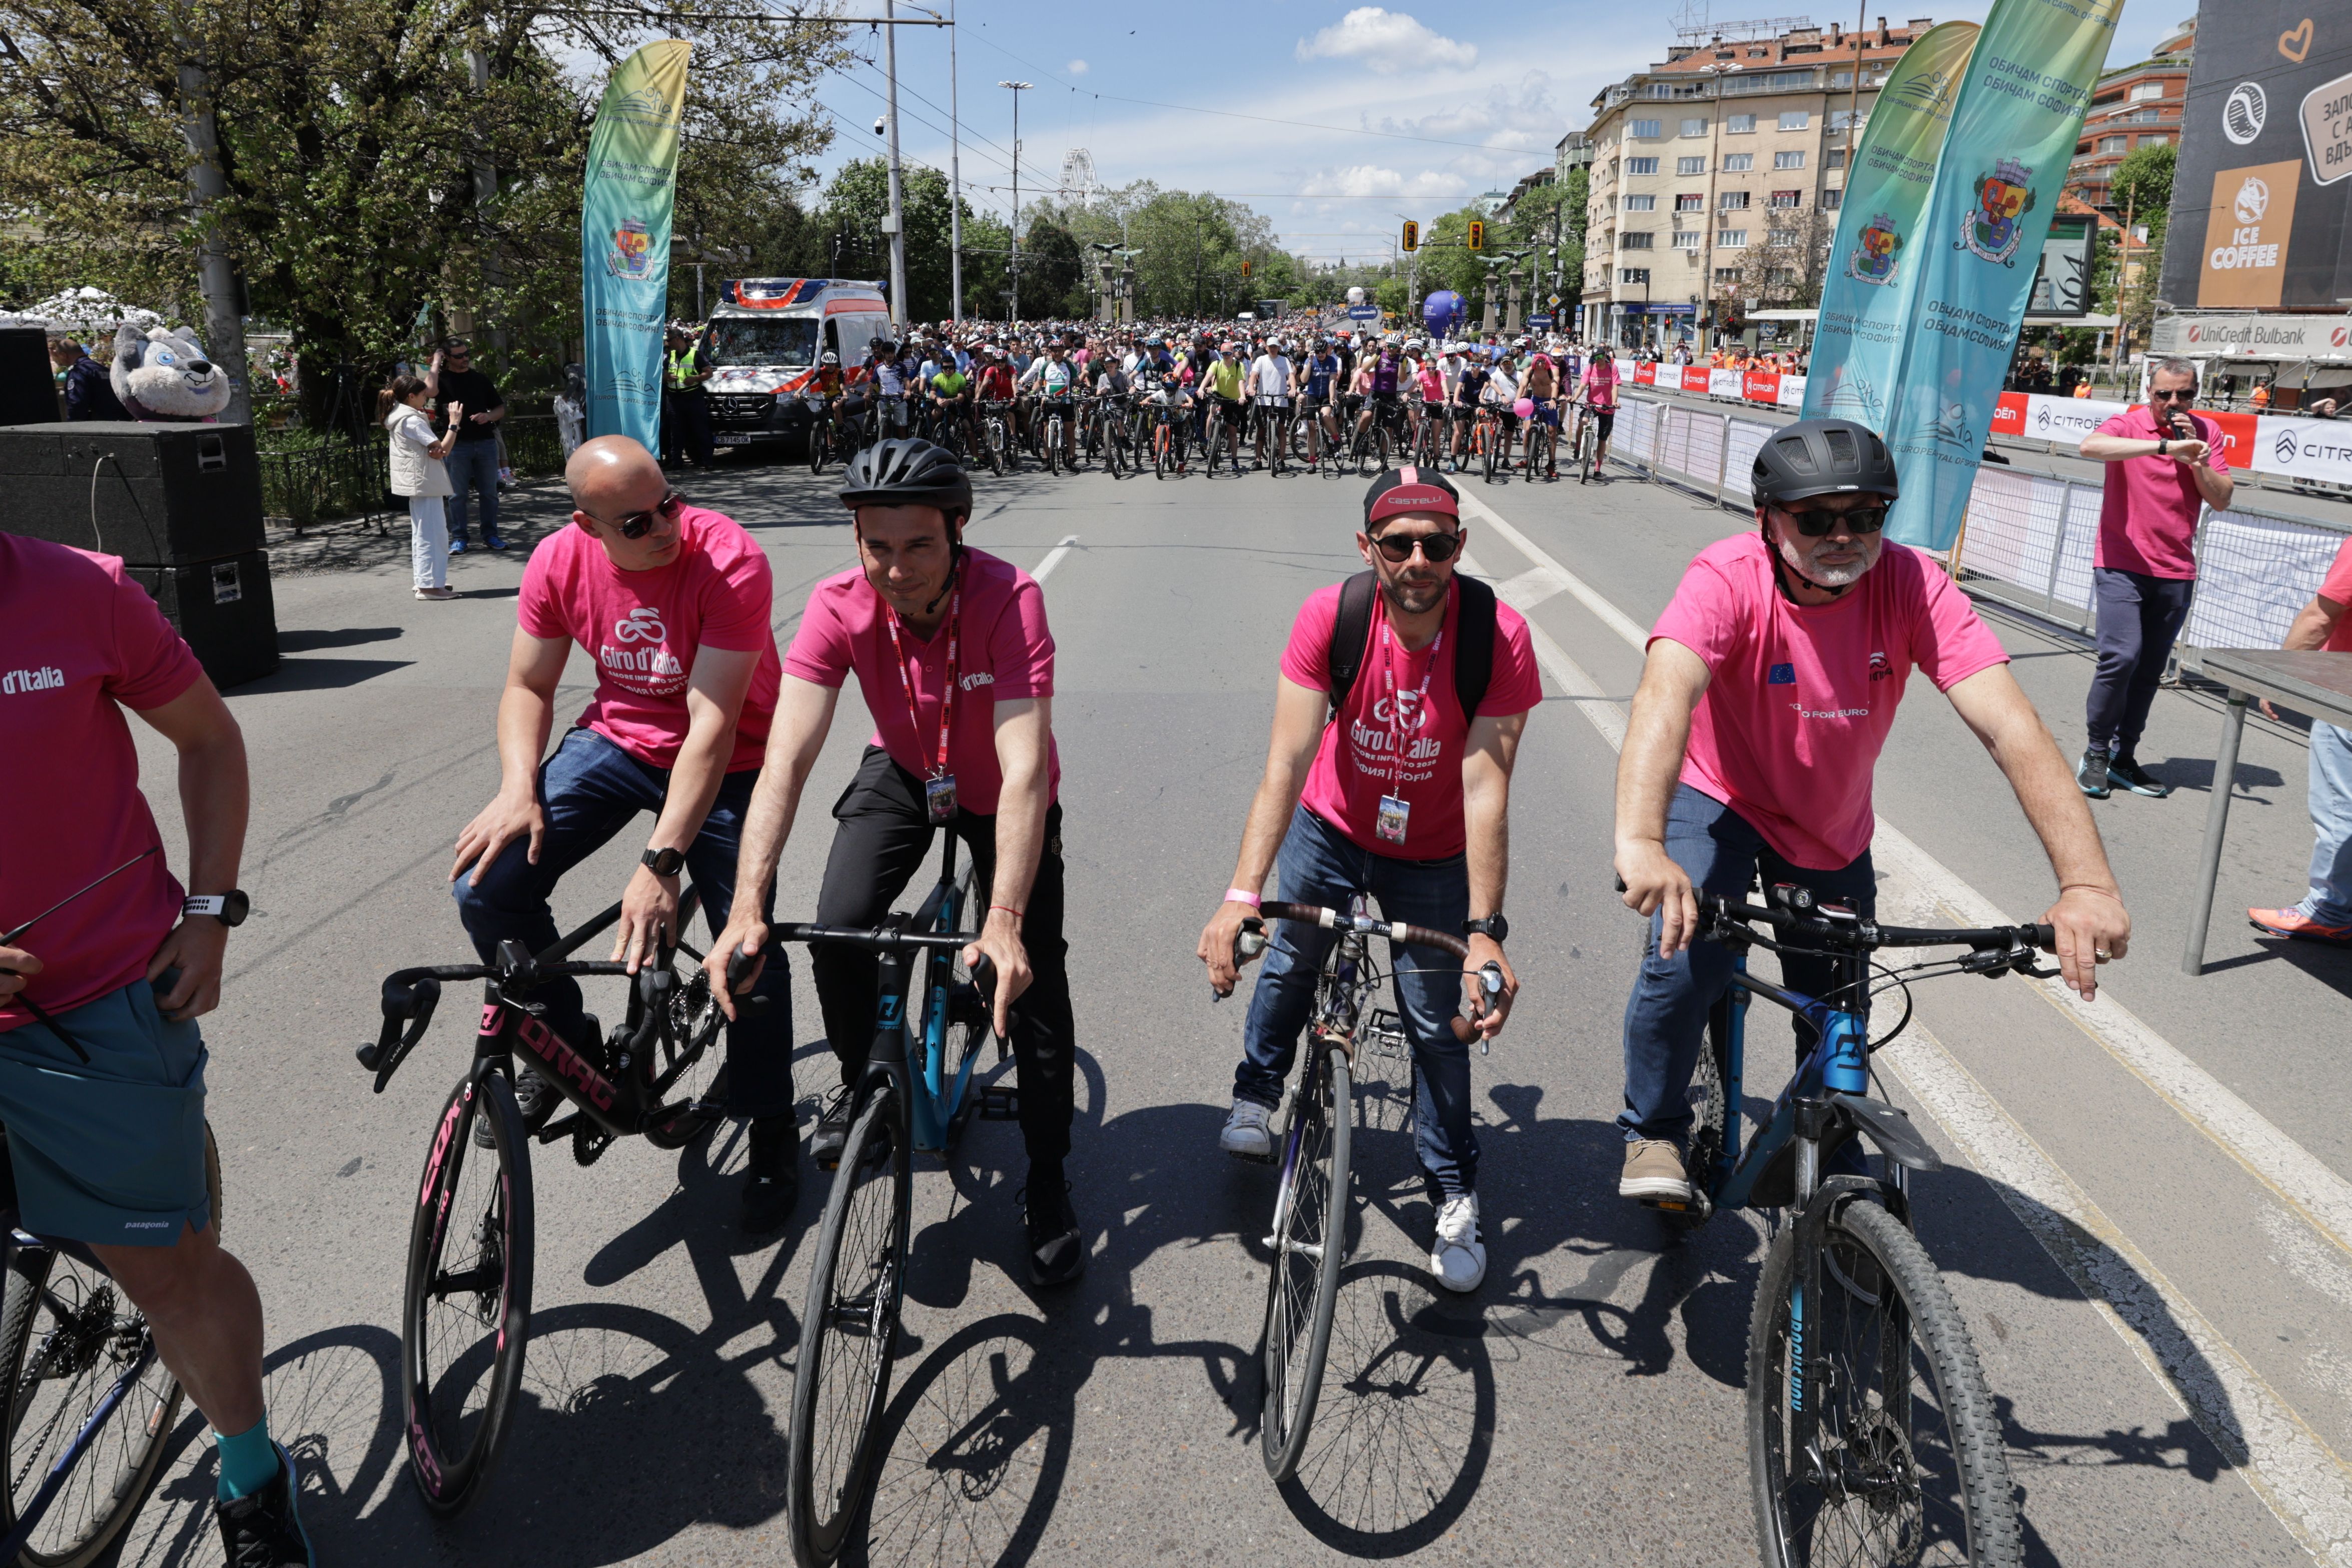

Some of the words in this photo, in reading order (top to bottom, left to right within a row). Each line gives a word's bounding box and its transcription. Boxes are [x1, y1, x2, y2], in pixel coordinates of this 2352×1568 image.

[2081, 11, 2093, 20] OF
[1989, 57, 2041, 84] ОБИЧАМ
[2042, 76, 2090, 105] СПОРТА,
[1885, 95, 1912, 109] EUROPEAN
[1984, 75, 2036, 102] ОБИЧАМ
[2037, 94, 2085, 119] СОФИЯ!
[1871, 145, 1905, 162] ОБИЧАМ
[601, 160, 637, 171] ОБИЧАМ
[1868, 158, 1900, 174] ОБИЧАМ
[1899, 169, 1934, 184] СОФИЯ!
[599, 171, 636, 182] ОБИЧАМ
[638, 176, 671, 187] СОФИЯ!
[2233, 227, 2260, 245] ICE
[2210, 244, 2278, 270] COFFEE
[595, 308, 627, 317] ОБИЧАМ
[1825, 312, 1860, 325] ОБИЧАМ
[1861, 320, 1903, 332] СПОРТА,
[596, 319, 628, 328] ОБИЧАМ
[628, 323, 660, 333] СОФИЯ!
[1823, 324, 1859, 336] ОБИЧАМ
[1860, 331, 1901, 344] СОФИЯ!
[2201, 326, 2251, 343] UniCredit
[2254, 326, 2305, 345] Bulbank
[1970, 330, 2010, 352] СОФИЯ!
[1805, 410, 1838, 418] EUROPEAN
[600, 644, 634, 670] Giro
[636, 646, 683, 674] d'Italia
[2, 666, 65, 694] d'Italia
[608, 670, 633, 680] AMORE
[635, 675, 666, 683] INFINITO
[963, 671, 995, 691] d'Italia
[1812, 710, 1836, 718] FOR
[1350, 718, 1384, 750] Giro
[1351, 741, 1376, 760] AMORE
[1416, 759, 1437, 768] 2026
[1351, 751, 1385, 777] СОФИЯ
[1394, 770, 1433, 781] SOFIA
[1378, 924, 1391, 932] ITM
[517, 1015, 617, 1112] DRAG
[125, 1221, 169, 1229] patagonia
